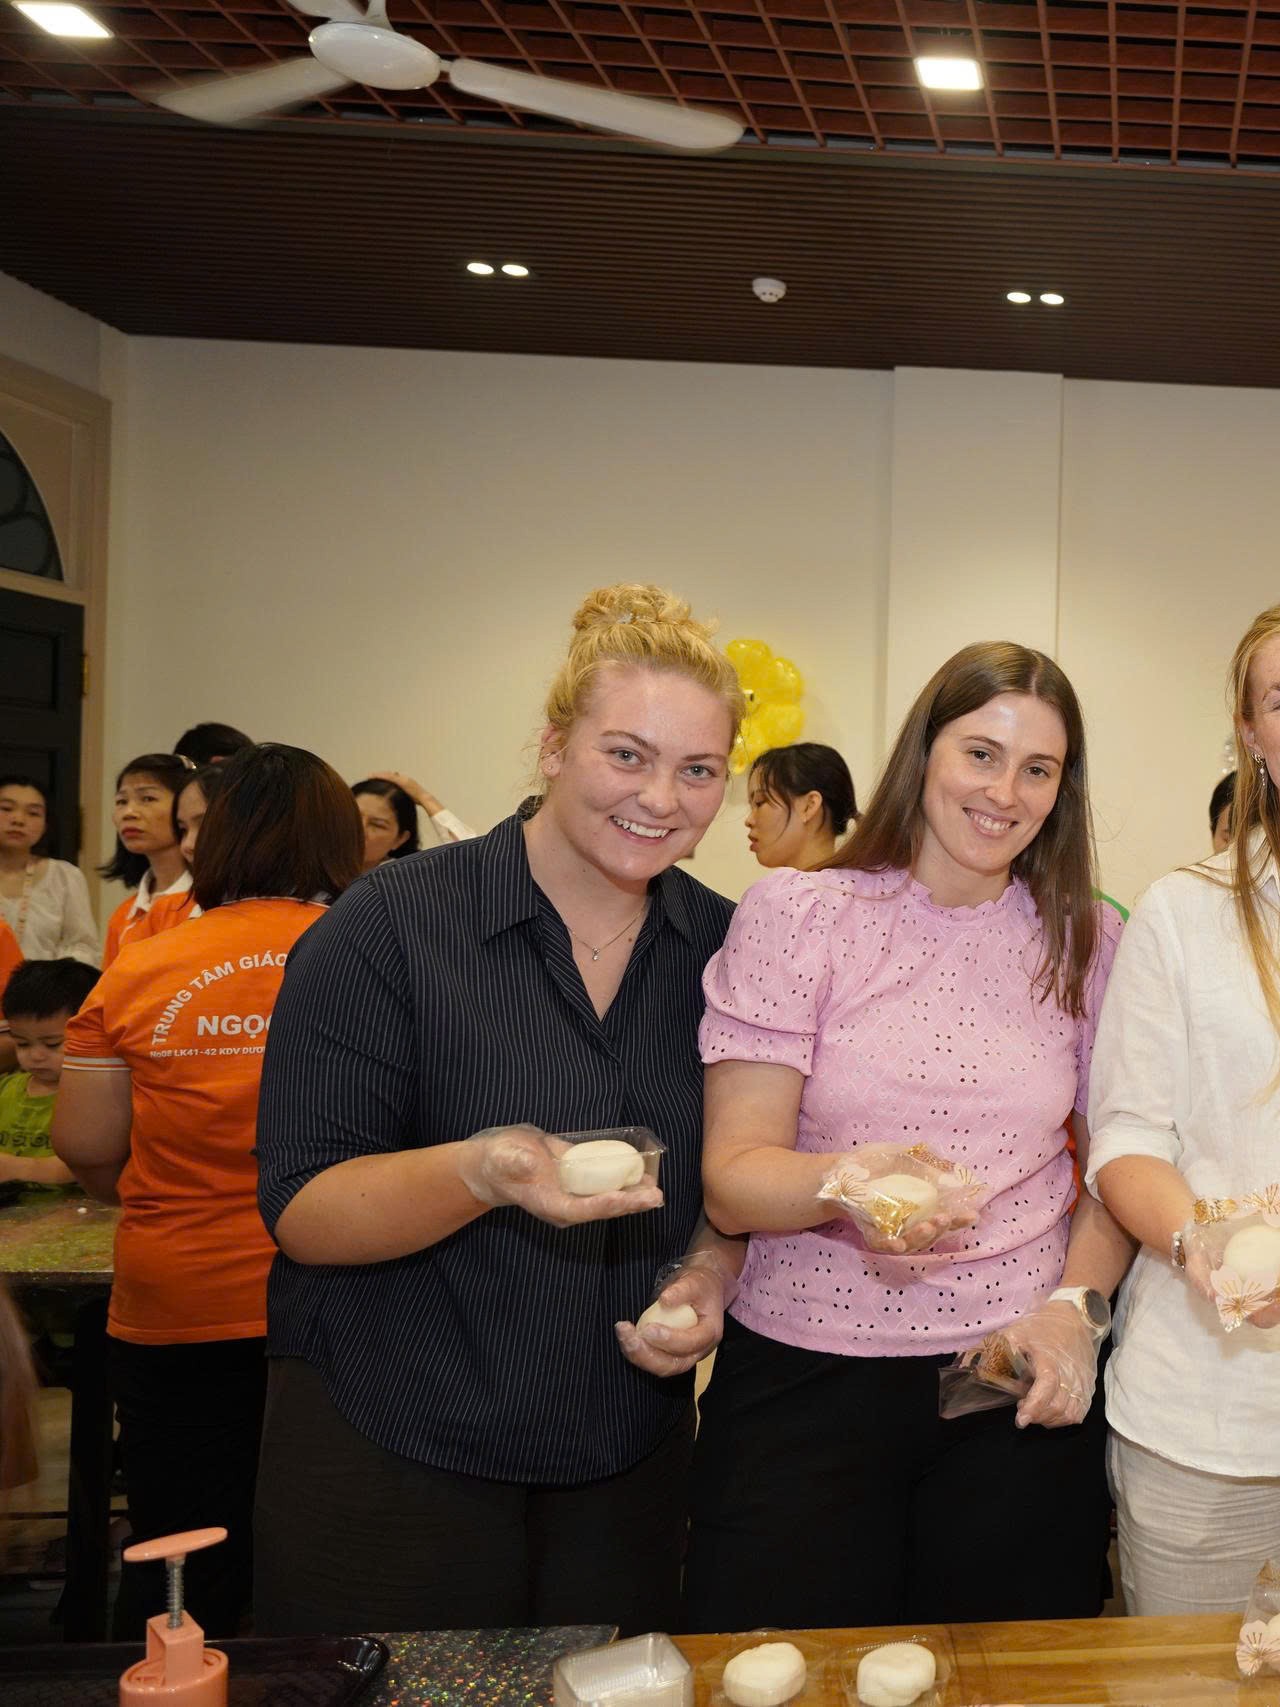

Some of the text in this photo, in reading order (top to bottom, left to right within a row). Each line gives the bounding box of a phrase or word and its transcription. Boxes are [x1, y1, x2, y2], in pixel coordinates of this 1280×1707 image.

[151, 950, 288, 1046] TRUNG TÂM GIÁO
